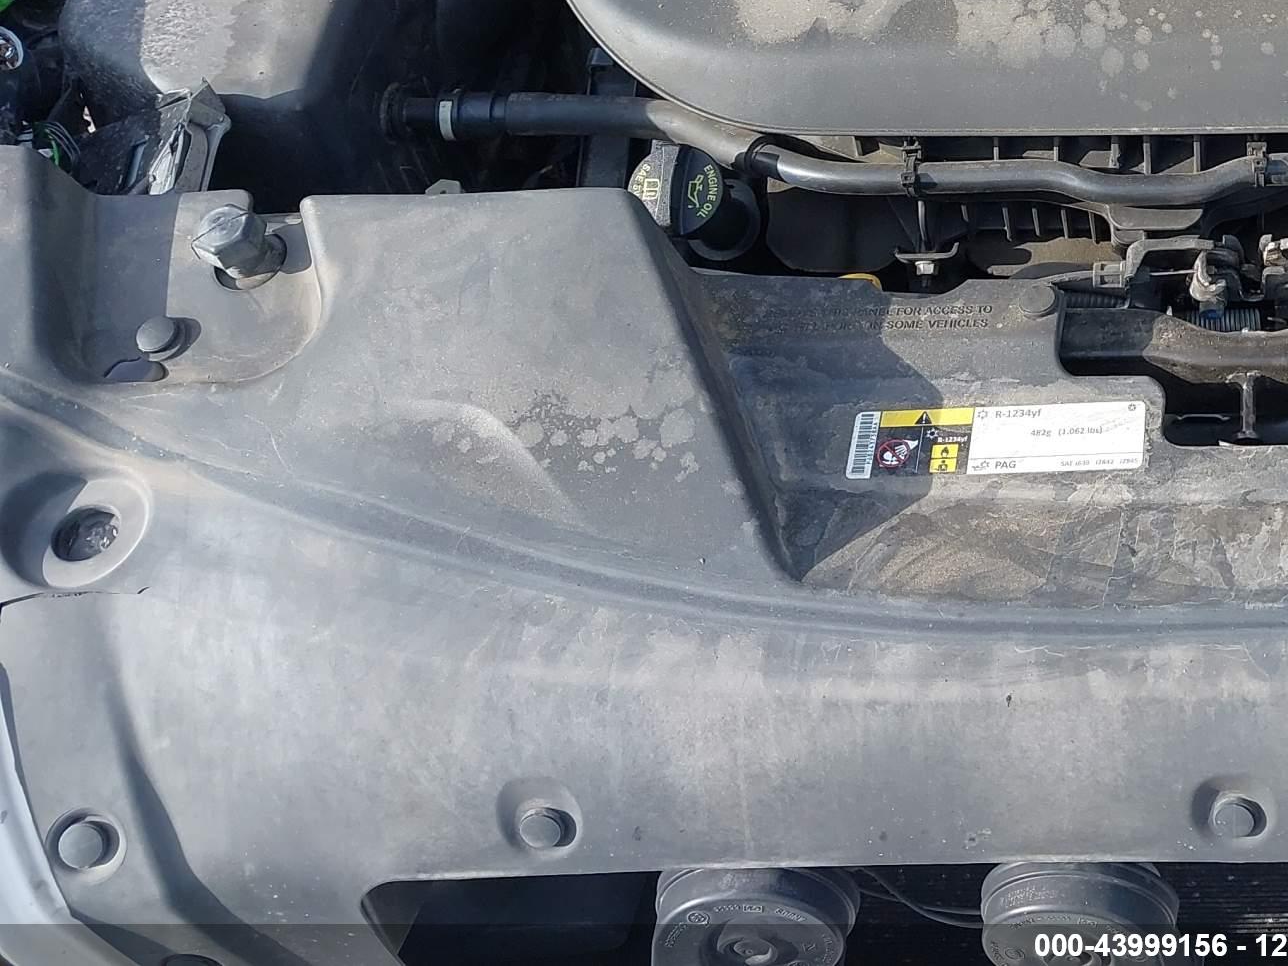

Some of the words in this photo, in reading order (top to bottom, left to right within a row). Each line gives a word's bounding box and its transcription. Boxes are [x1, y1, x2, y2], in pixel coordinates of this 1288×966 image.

[635, 163, 651, 182] SAE
[703, 164, 717, 202] ENGINE
[697, 203, 713, 218] OIL
[896, 305, 921, 316] FOR
[924, 305, 974, 316] ACCESS
[976, 304, 993, 315] TO
[886, 319, 923, 330] SOME
[927, 318, 988, 329] VEHICLES
[995, 408, 1043, 419] R-1234yf
[937, 435, 968, 444] R-1234yf
[995, 459, 1017, 470] PAG
